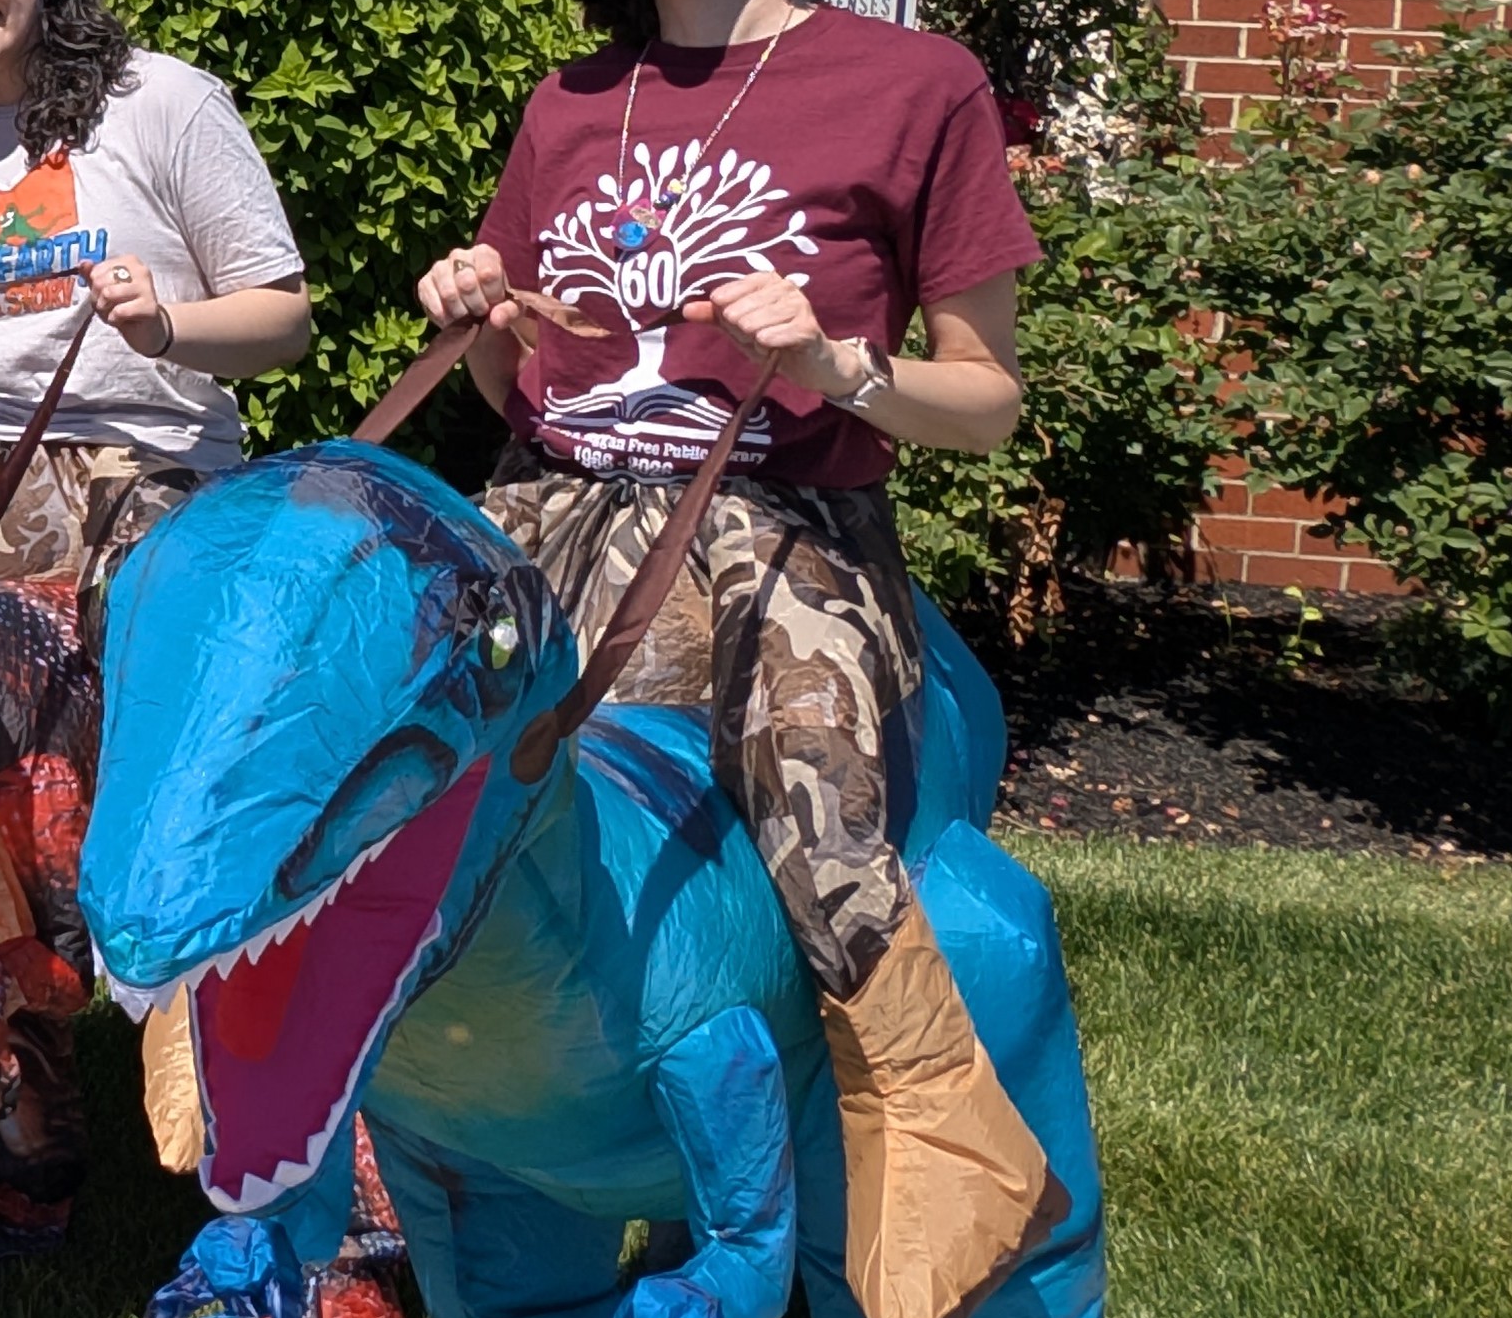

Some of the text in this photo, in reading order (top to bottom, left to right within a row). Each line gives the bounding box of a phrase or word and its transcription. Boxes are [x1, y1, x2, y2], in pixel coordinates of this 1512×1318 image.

[620, 251, 674, 308] 60
[627, 438, 660, 456] Free
[663, 442, 709, 460] Public
